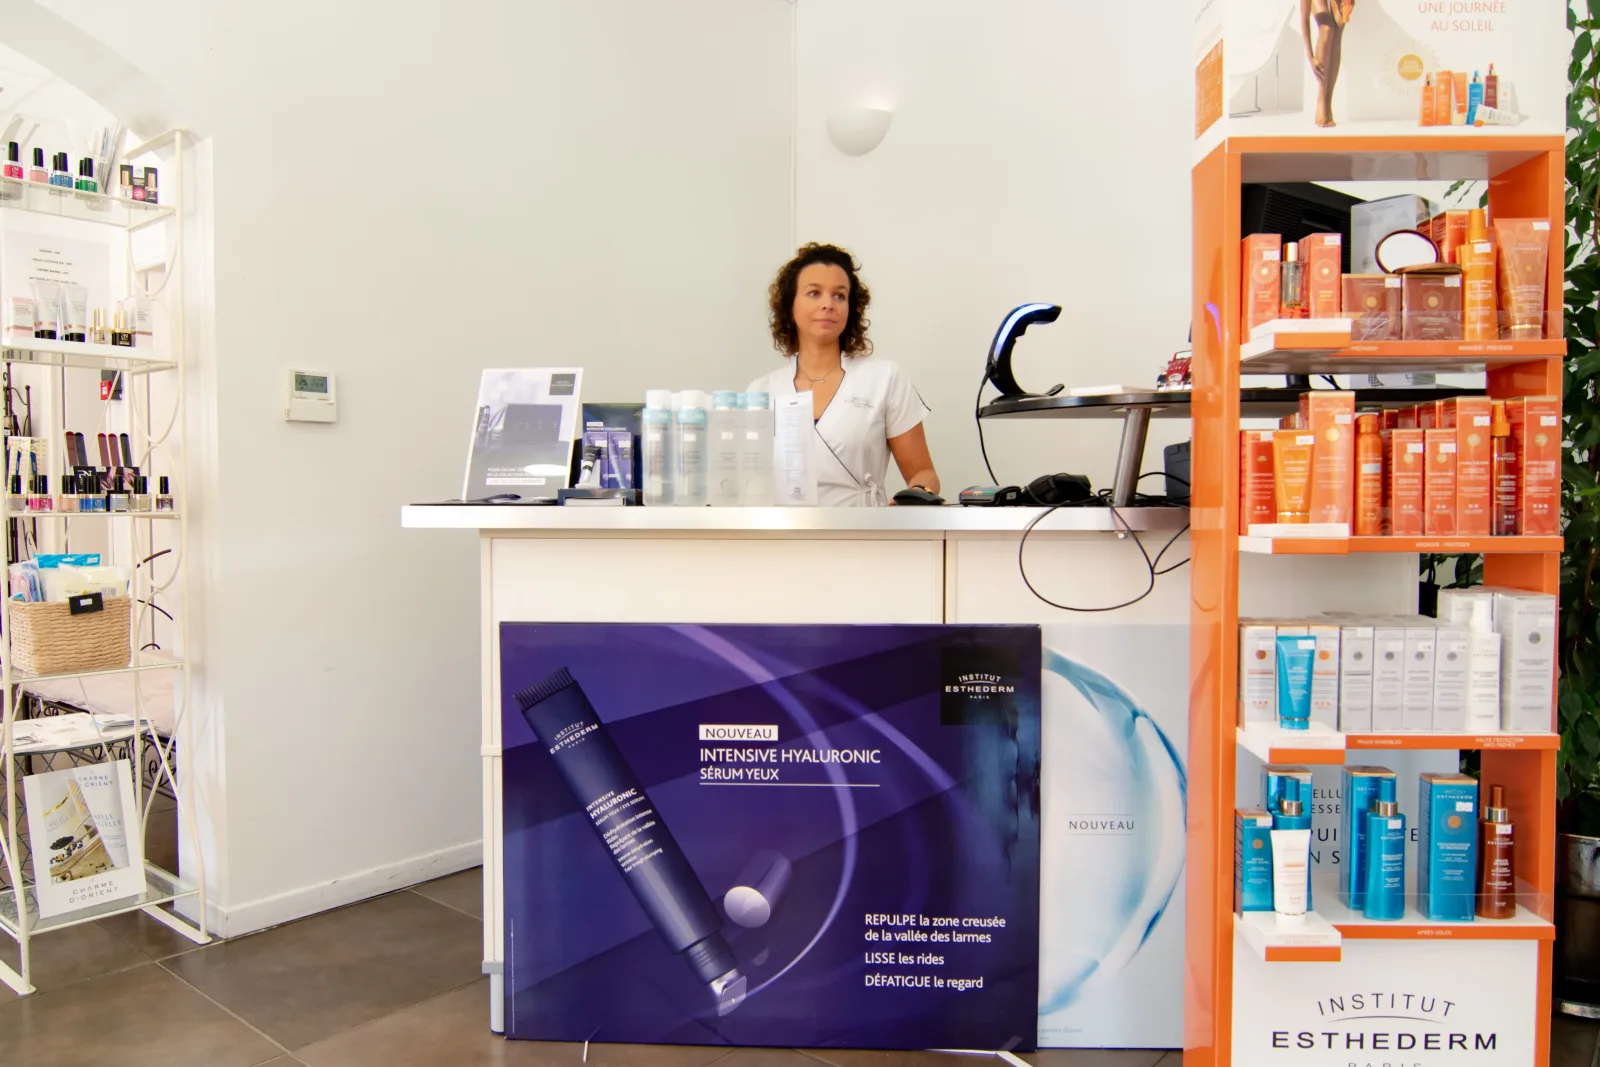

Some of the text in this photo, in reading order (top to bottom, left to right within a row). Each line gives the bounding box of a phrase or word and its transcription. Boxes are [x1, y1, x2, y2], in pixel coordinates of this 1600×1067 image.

[1418, 2, 1445, 13] UNE
[1430, 20, 1494, 31] AU SOLEIL
[958, 673, 1001, 682] INSTITUT
[945, 685, 1015, 693] ESTHEDERM
[550, 723, 599, 755] ESTHEDERM
[554, 721, 584, 742] INSTITUT
[705, 728, 772, 739] NOUVEAU
[700, 748, 881, 765] INTENSIVE HYALURONIC
[700, 765, 780, 781] SÉRUM YEUX
[585, 790, 615, 812] INTENSIVE
[589, 787, 638, 820] HYALURONIC
[1069, 820, 1135, 831] NOUVEAU
[72, 880, 114, 895] CHARME
[865, 913, 1006, 928] REPULPE la zone creusée
[865, 929, 992, 944] de la vallée des larmes
[865, 952, 945, 966] LISSE les rides
[865, 972, 984, 991] DÉFATIGUE le regard
[1317, 993, 1456, 1018] INSTITUT
[1272, 1031, 1498, 1051] ESTHEDERM
